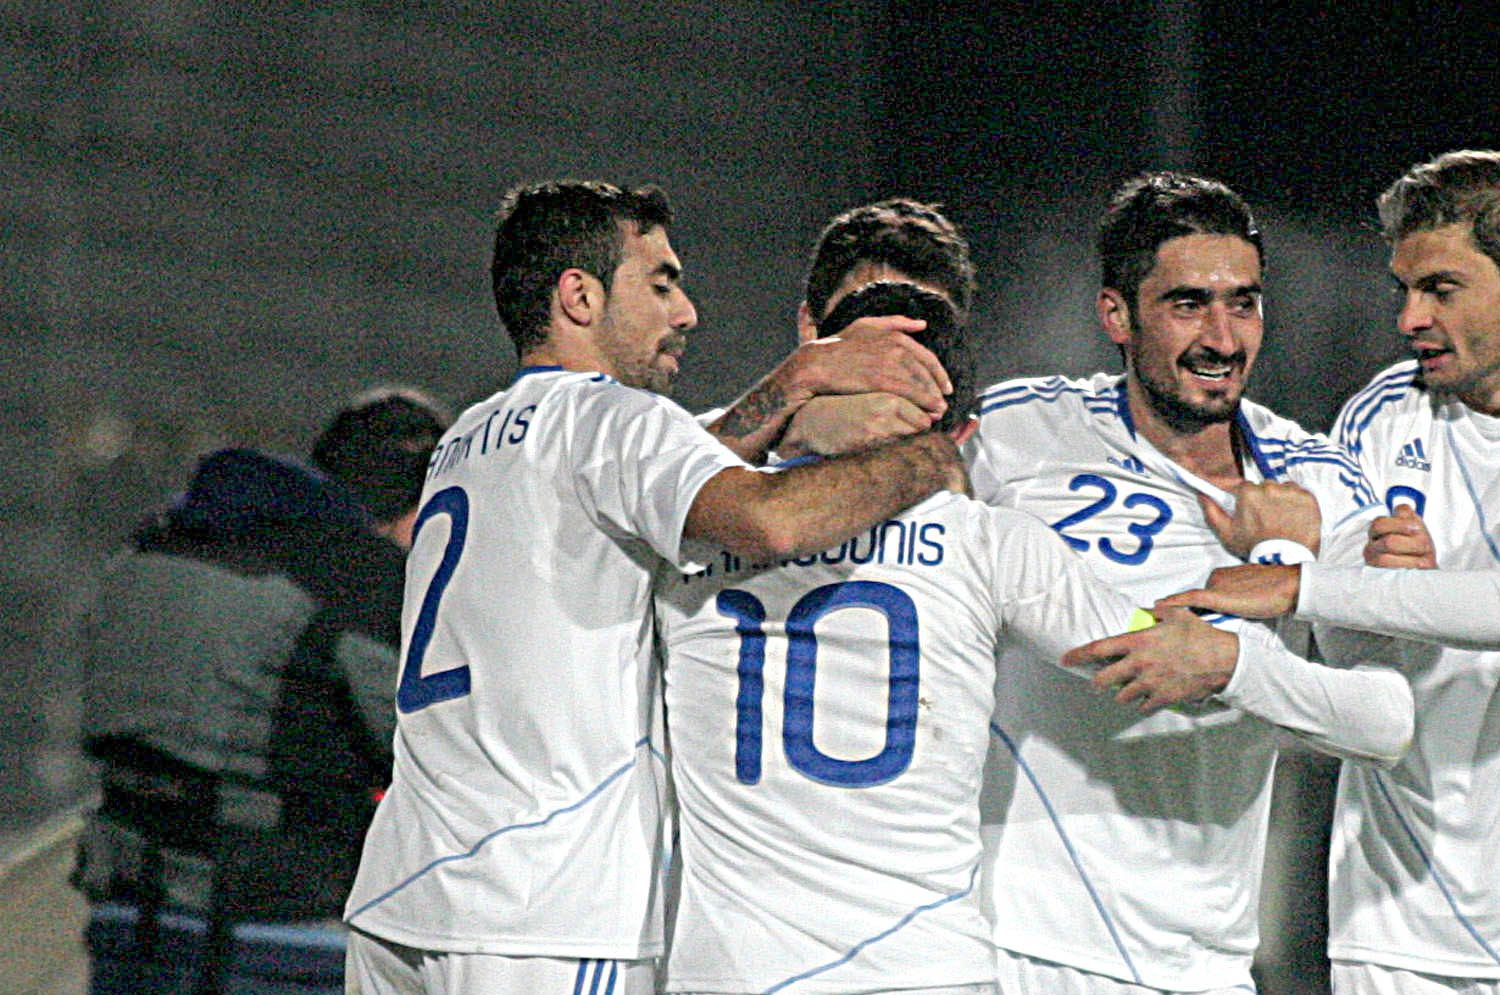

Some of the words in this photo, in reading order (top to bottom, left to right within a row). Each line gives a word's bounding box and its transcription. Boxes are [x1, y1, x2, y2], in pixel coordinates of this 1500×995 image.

[396, 486, 471, 713] 2
[1050, 474, 1173, 566] 23
[716, 580, 919, 789] 10
